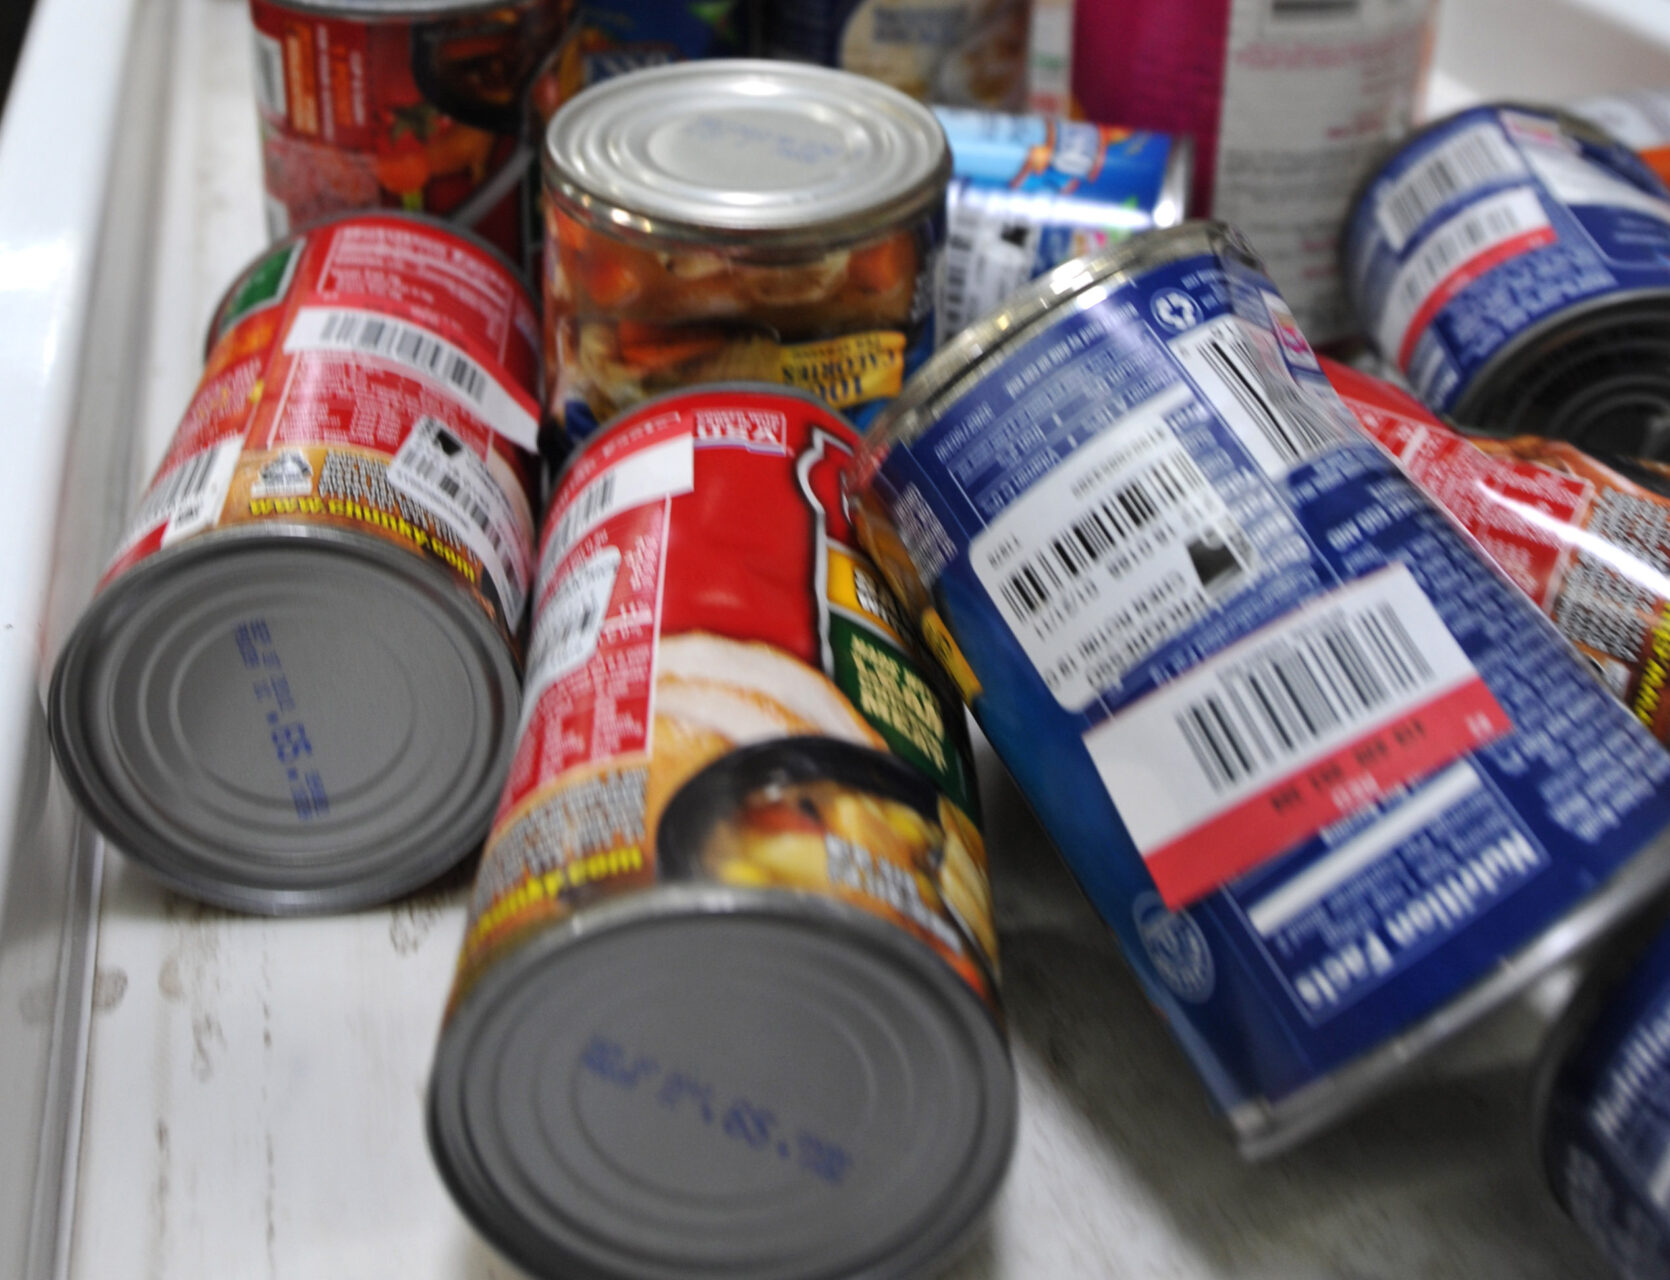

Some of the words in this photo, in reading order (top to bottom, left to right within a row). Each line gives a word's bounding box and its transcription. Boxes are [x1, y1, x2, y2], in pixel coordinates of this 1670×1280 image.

[249, 497, 476, 584] www.chunky.com
[1379, 827, 1540, 956] Nutrition
[1290, 928, 1395, 1014] Facts
